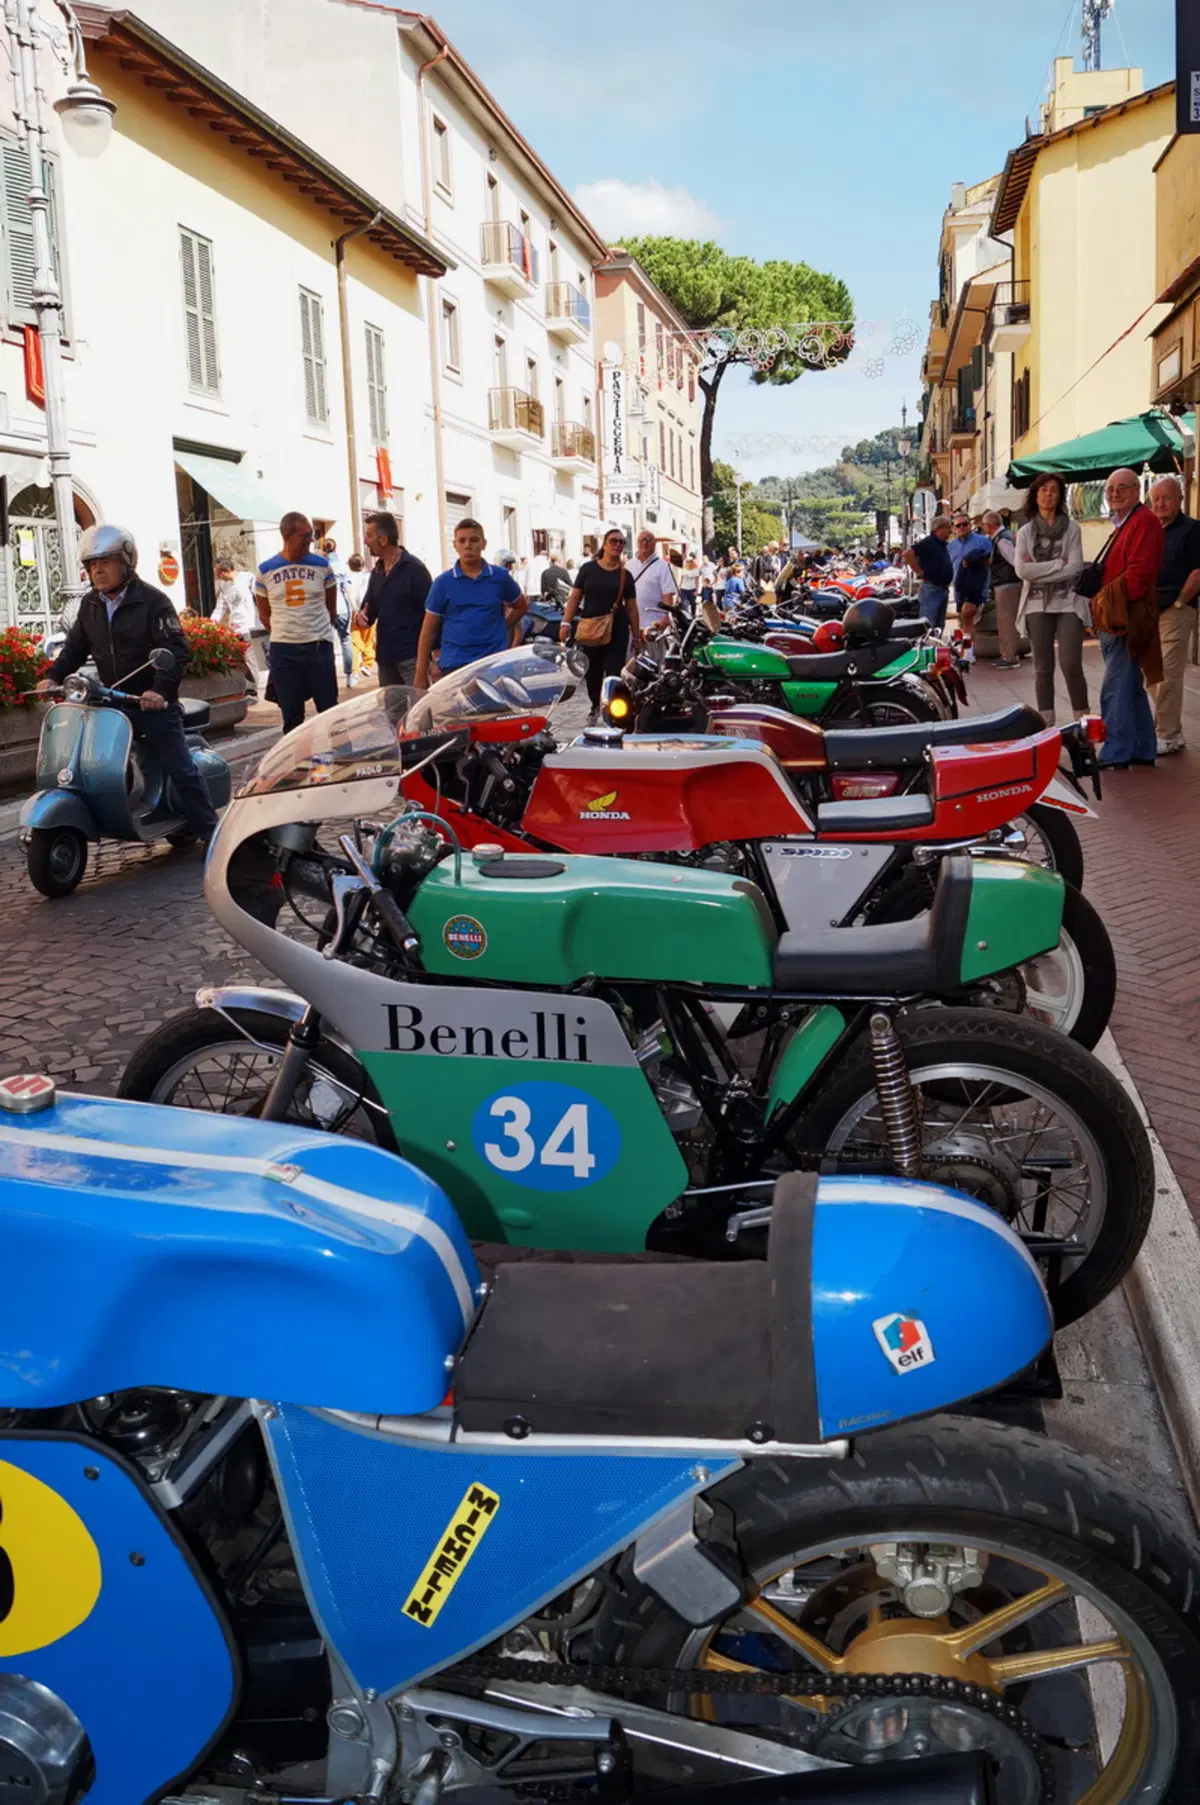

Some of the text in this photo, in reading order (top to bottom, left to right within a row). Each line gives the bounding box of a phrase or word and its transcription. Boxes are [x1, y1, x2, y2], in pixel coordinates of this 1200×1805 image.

[273, 567, 316, 584] DATCH
[356, 764, 382, 777] PAOLO
[977, 784, 1033, 803] HONDA
[578, 811, 632, 820] HONDA
[448, 933, 482, 943] BENELLI
[381, 1003, 592, 1063] Benelli
[484, 1095, 596, 1178] 34
[898, 1346, 924, 1367] elf
[407, 1487, 498, 1624] MICHELIN
